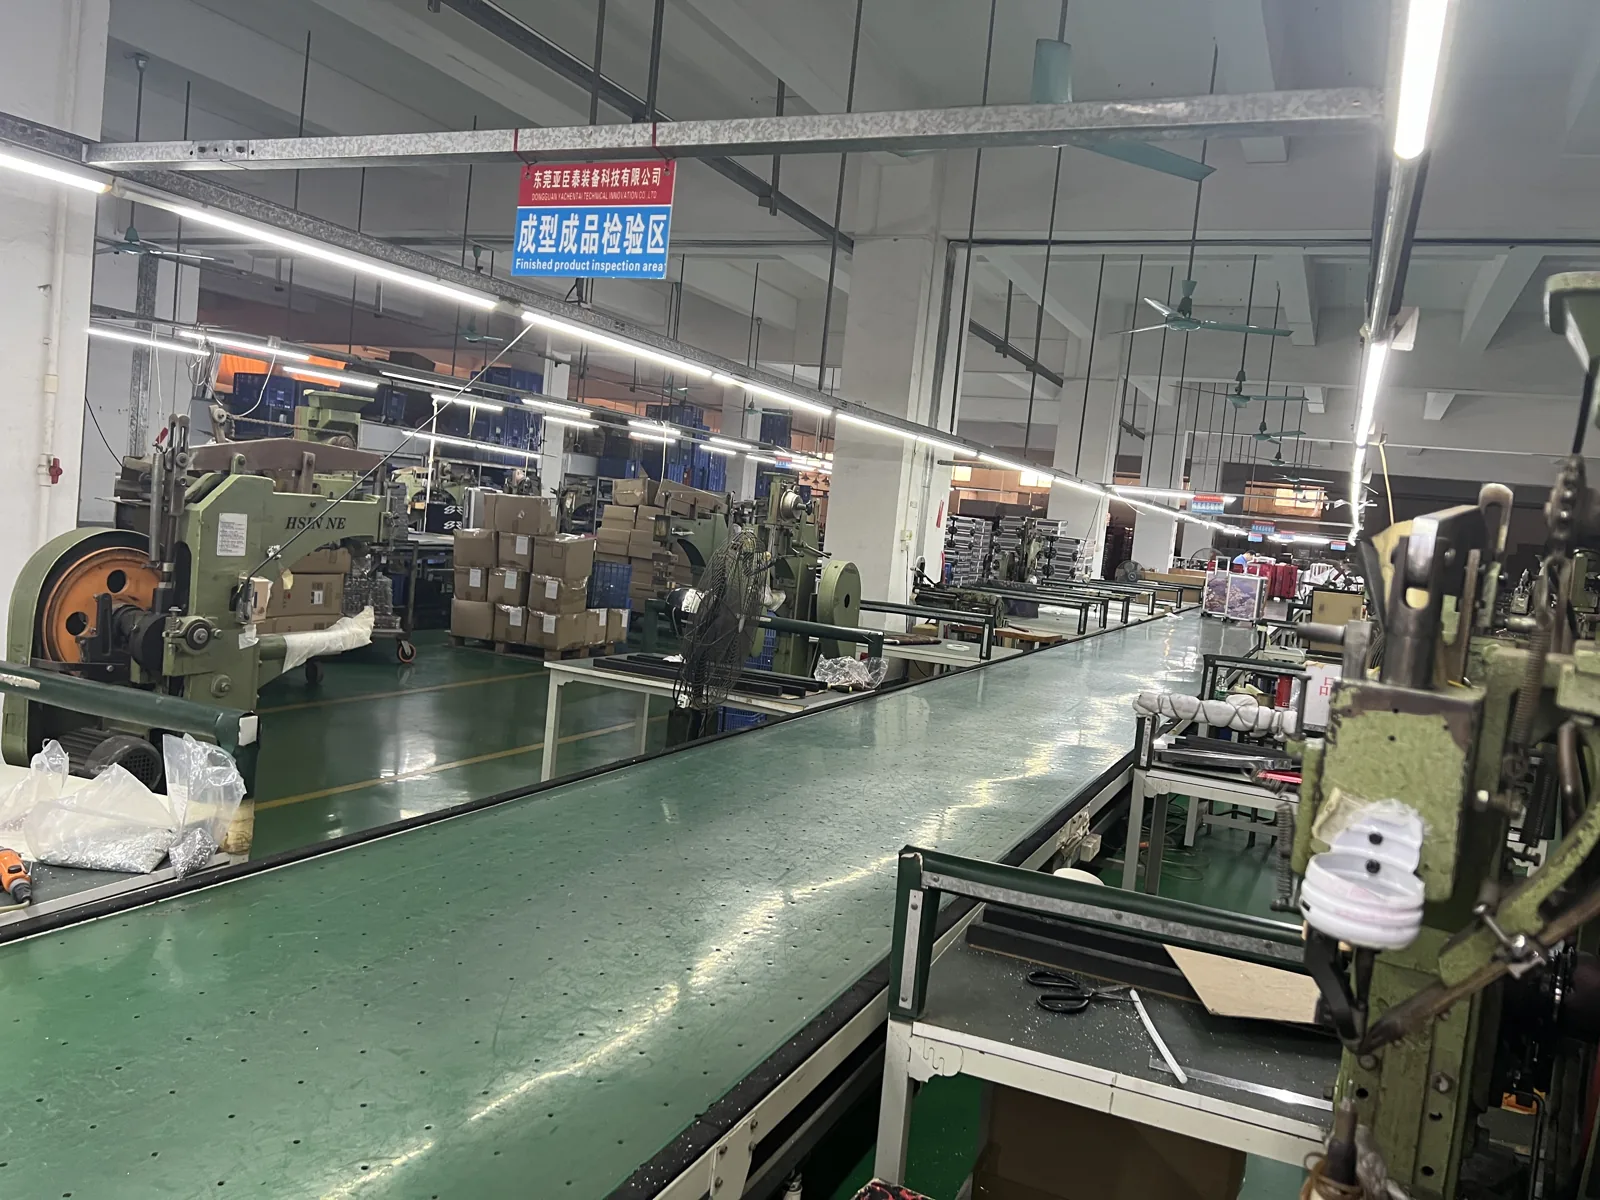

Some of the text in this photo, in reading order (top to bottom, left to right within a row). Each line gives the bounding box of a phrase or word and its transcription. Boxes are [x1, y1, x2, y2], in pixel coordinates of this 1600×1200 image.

[517, 212, 667, 255] 成型成品检验区
[515, 258, 664, 273] Finished product inspection area
